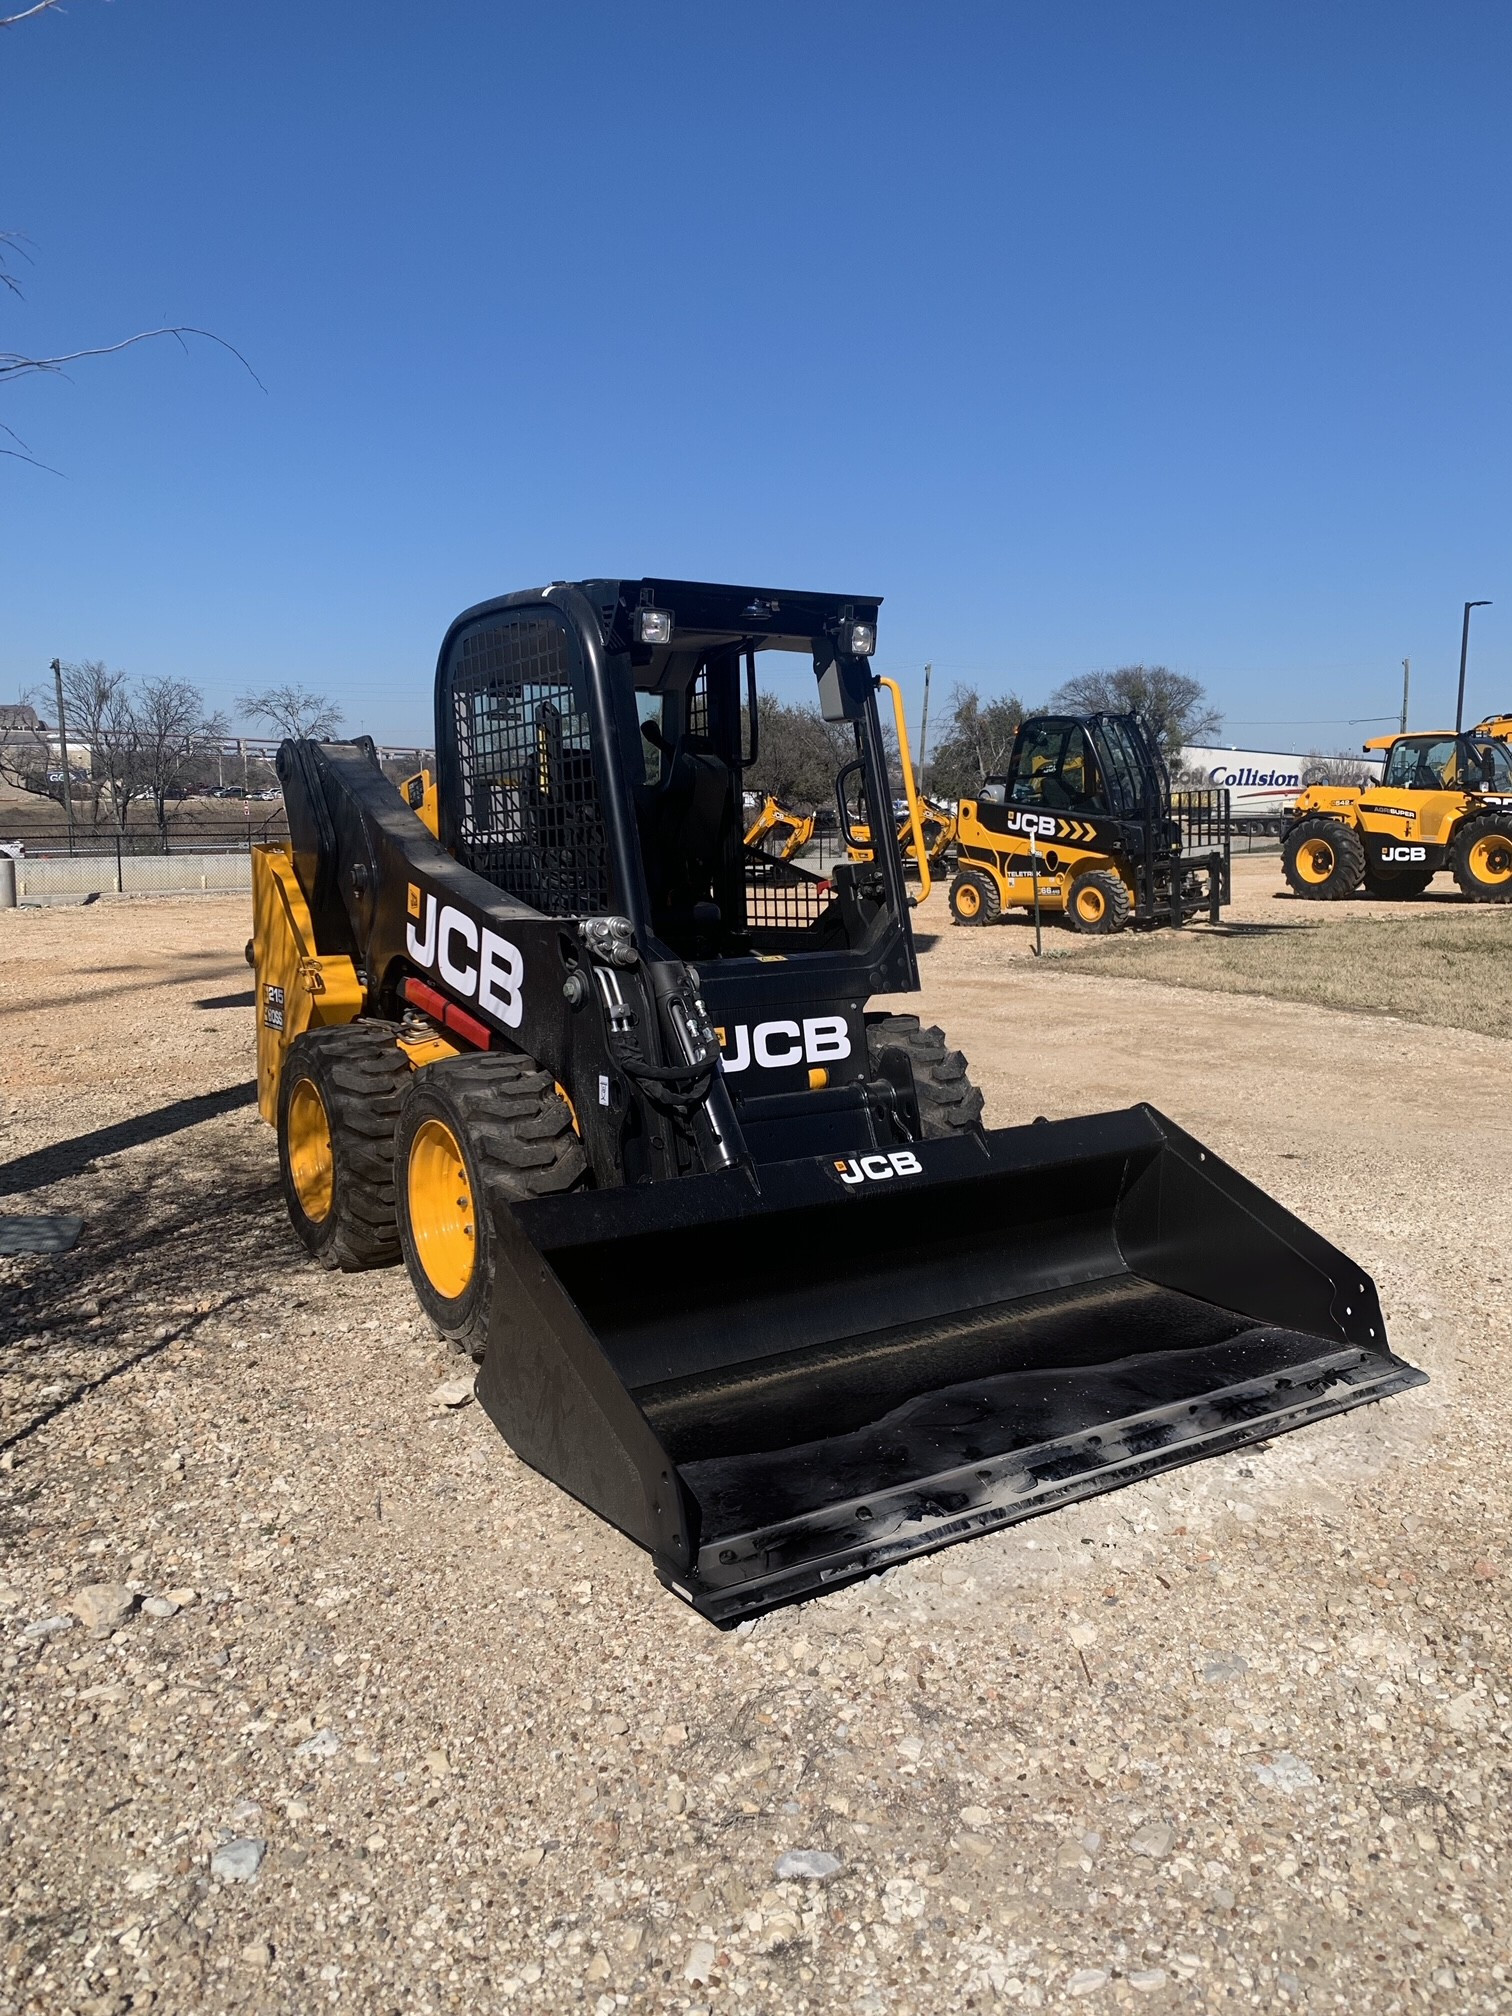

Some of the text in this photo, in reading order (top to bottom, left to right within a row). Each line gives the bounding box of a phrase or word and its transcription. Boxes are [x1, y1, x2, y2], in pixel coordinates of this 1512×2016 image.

[1208, 766, 1299, 787] Collision
[1007, 812, 1056, 836] JCB
[1382, 847, 1426, 862] JCB
[406, 893, 524, 1030] JCB
[720, 1015, 852, 1074] JCB
[840, 1151, 924, 1185] JCB
